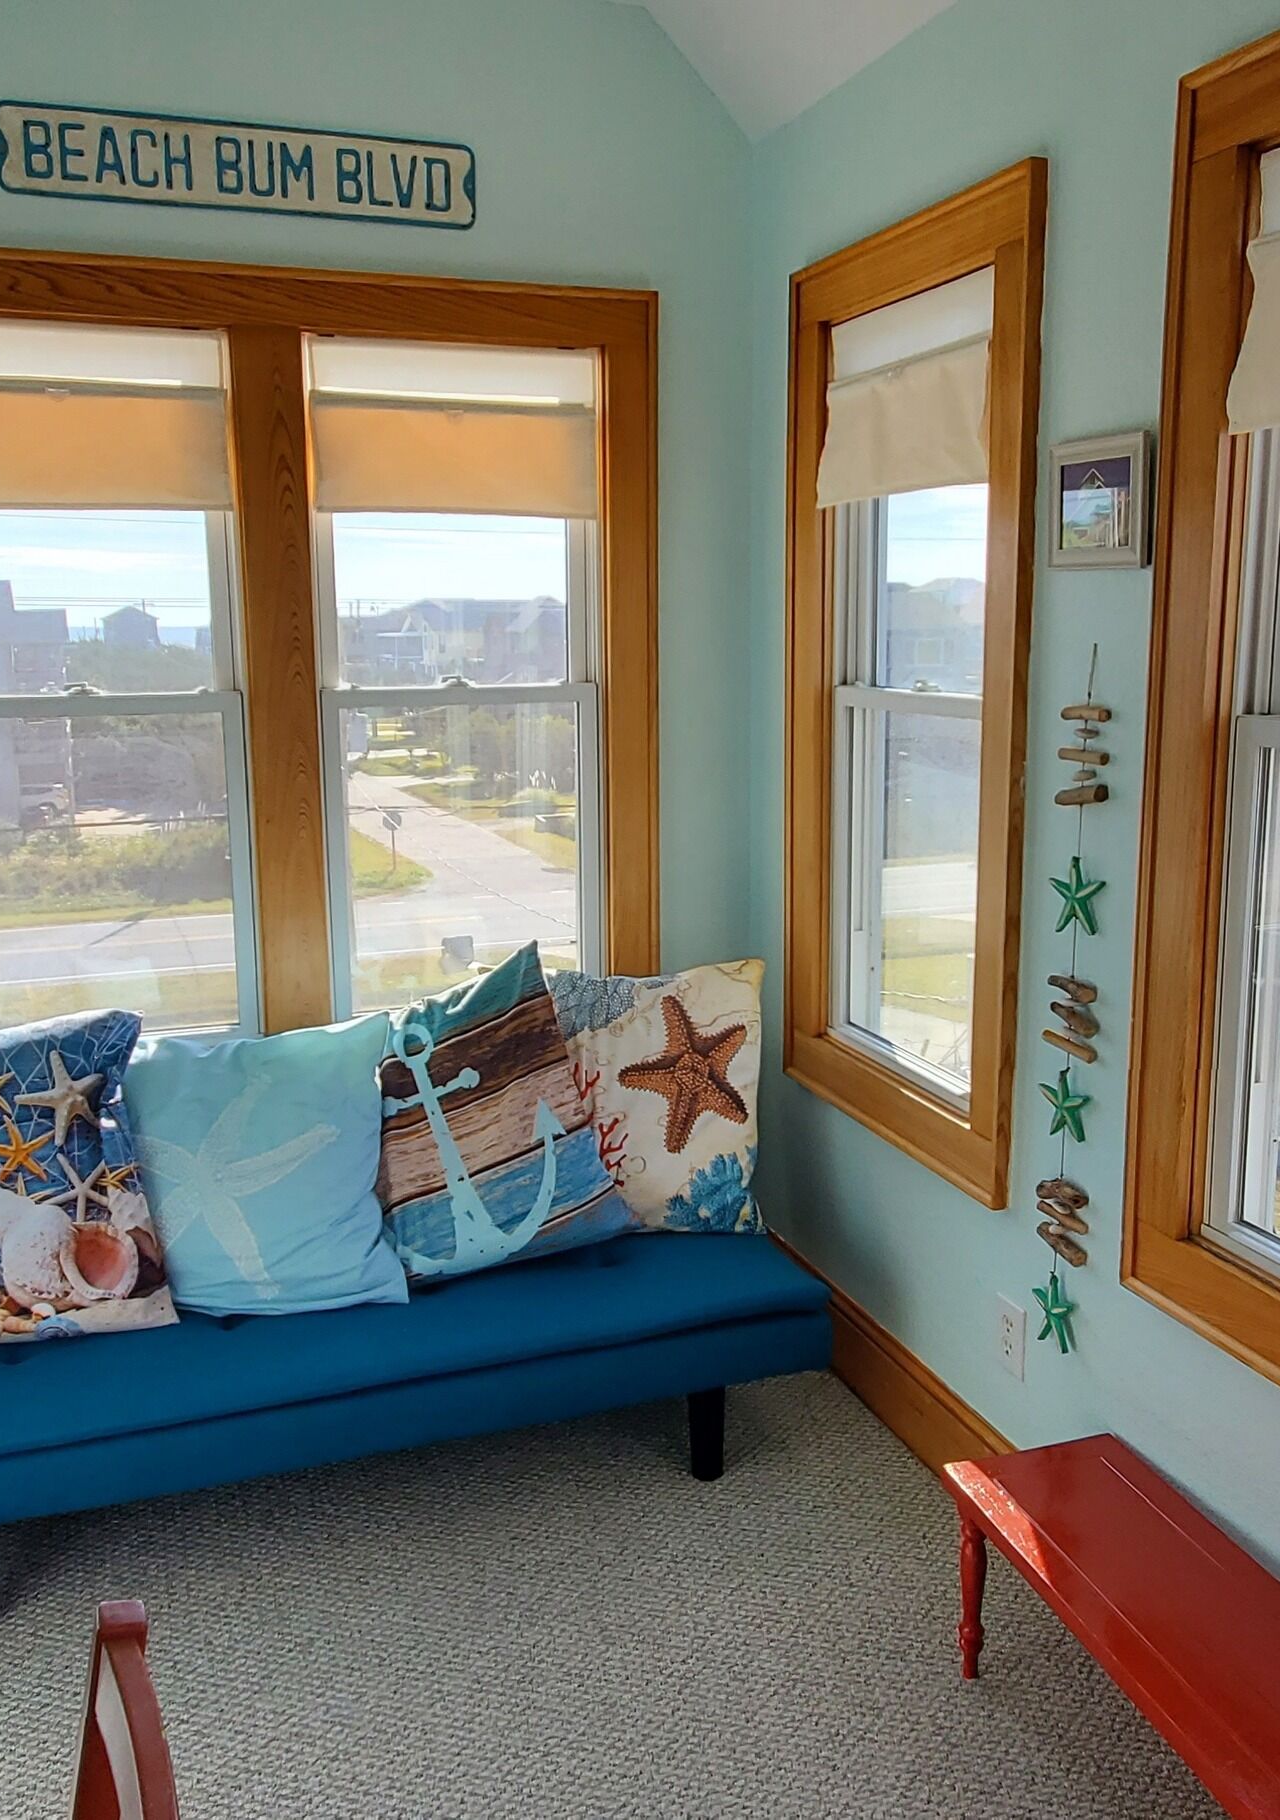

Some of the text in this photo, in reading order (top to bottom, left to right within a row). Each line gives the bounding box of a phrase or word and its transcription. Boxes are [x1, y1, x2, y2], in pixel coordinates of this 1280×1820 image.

[23, 119, 452, 212] BEACH BUM BLVD
